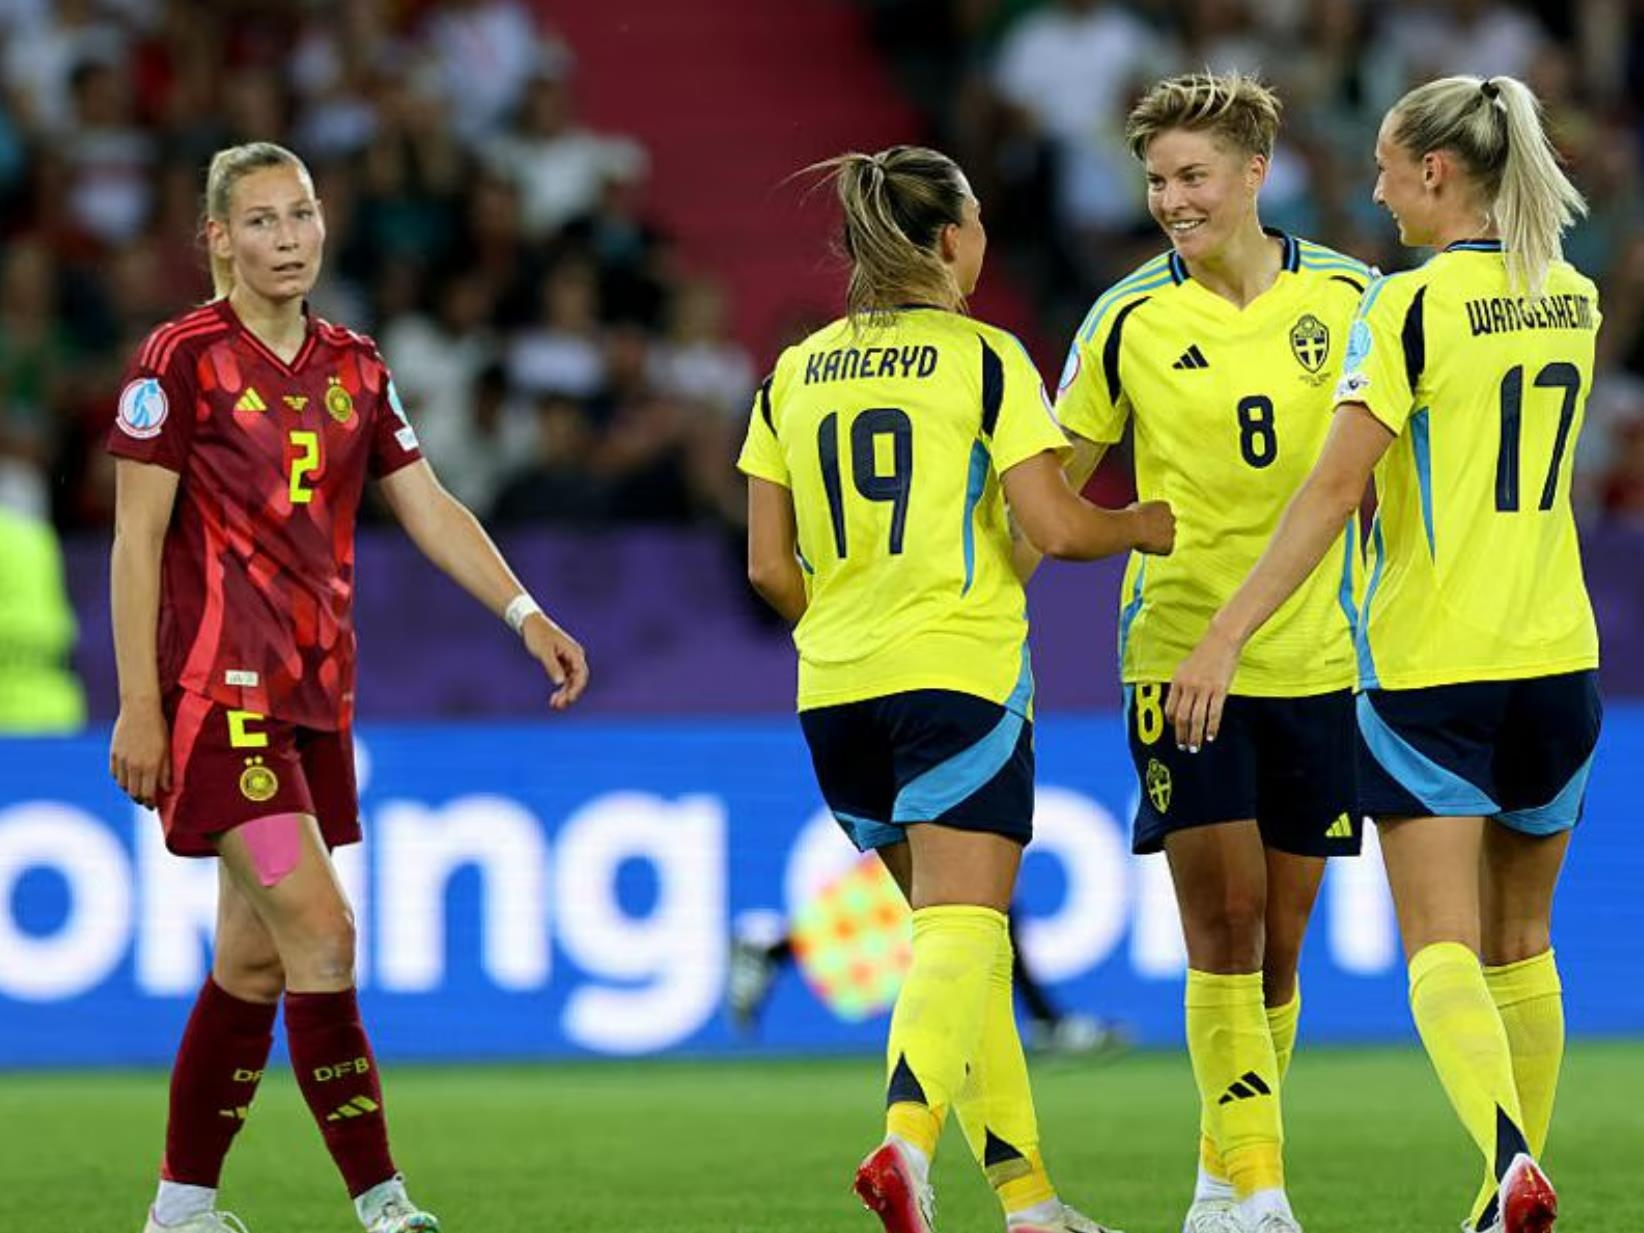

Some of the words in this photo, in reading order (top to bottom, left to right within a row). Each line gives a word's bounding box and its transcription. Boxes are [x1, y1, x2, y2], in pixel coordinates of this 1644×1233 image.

[804, 346, 938, 386] KANERYD
[1237, 395, 1277, 469] 8
[1495, 362, 1581, 512] 17
[289, 431, 319, 503] 2
[817, 408, 913, 558] 19
[1135, 682, 1164, 745] 8
[232, 1068, 265, 1082] DF
[313, 1057, 370, 1082] DFB
